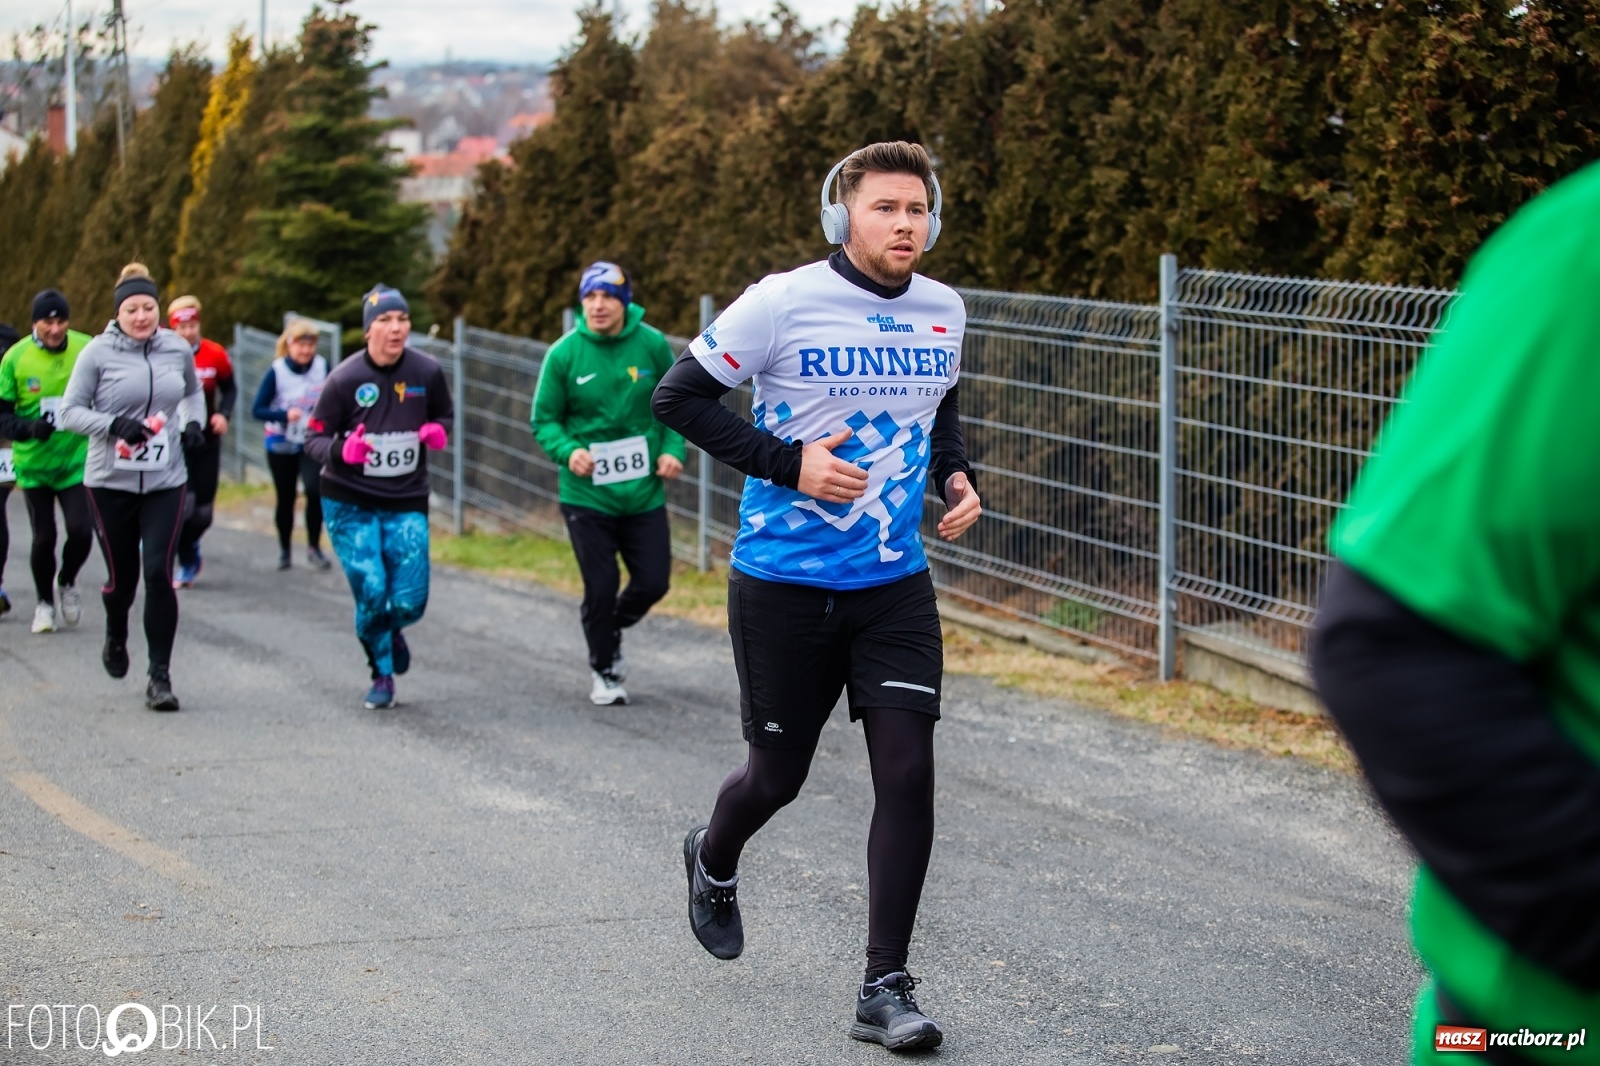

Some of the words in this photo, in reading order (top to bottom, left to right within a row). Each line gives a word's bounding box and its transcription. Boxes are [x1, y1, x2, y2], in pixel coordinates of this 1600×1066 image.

[829, 386, 908, 397] EKO-OKNA
[118, 444, 165, 461] 27
[368, 448, 415, 468] 369
[596, 452, 645, 476] 368
